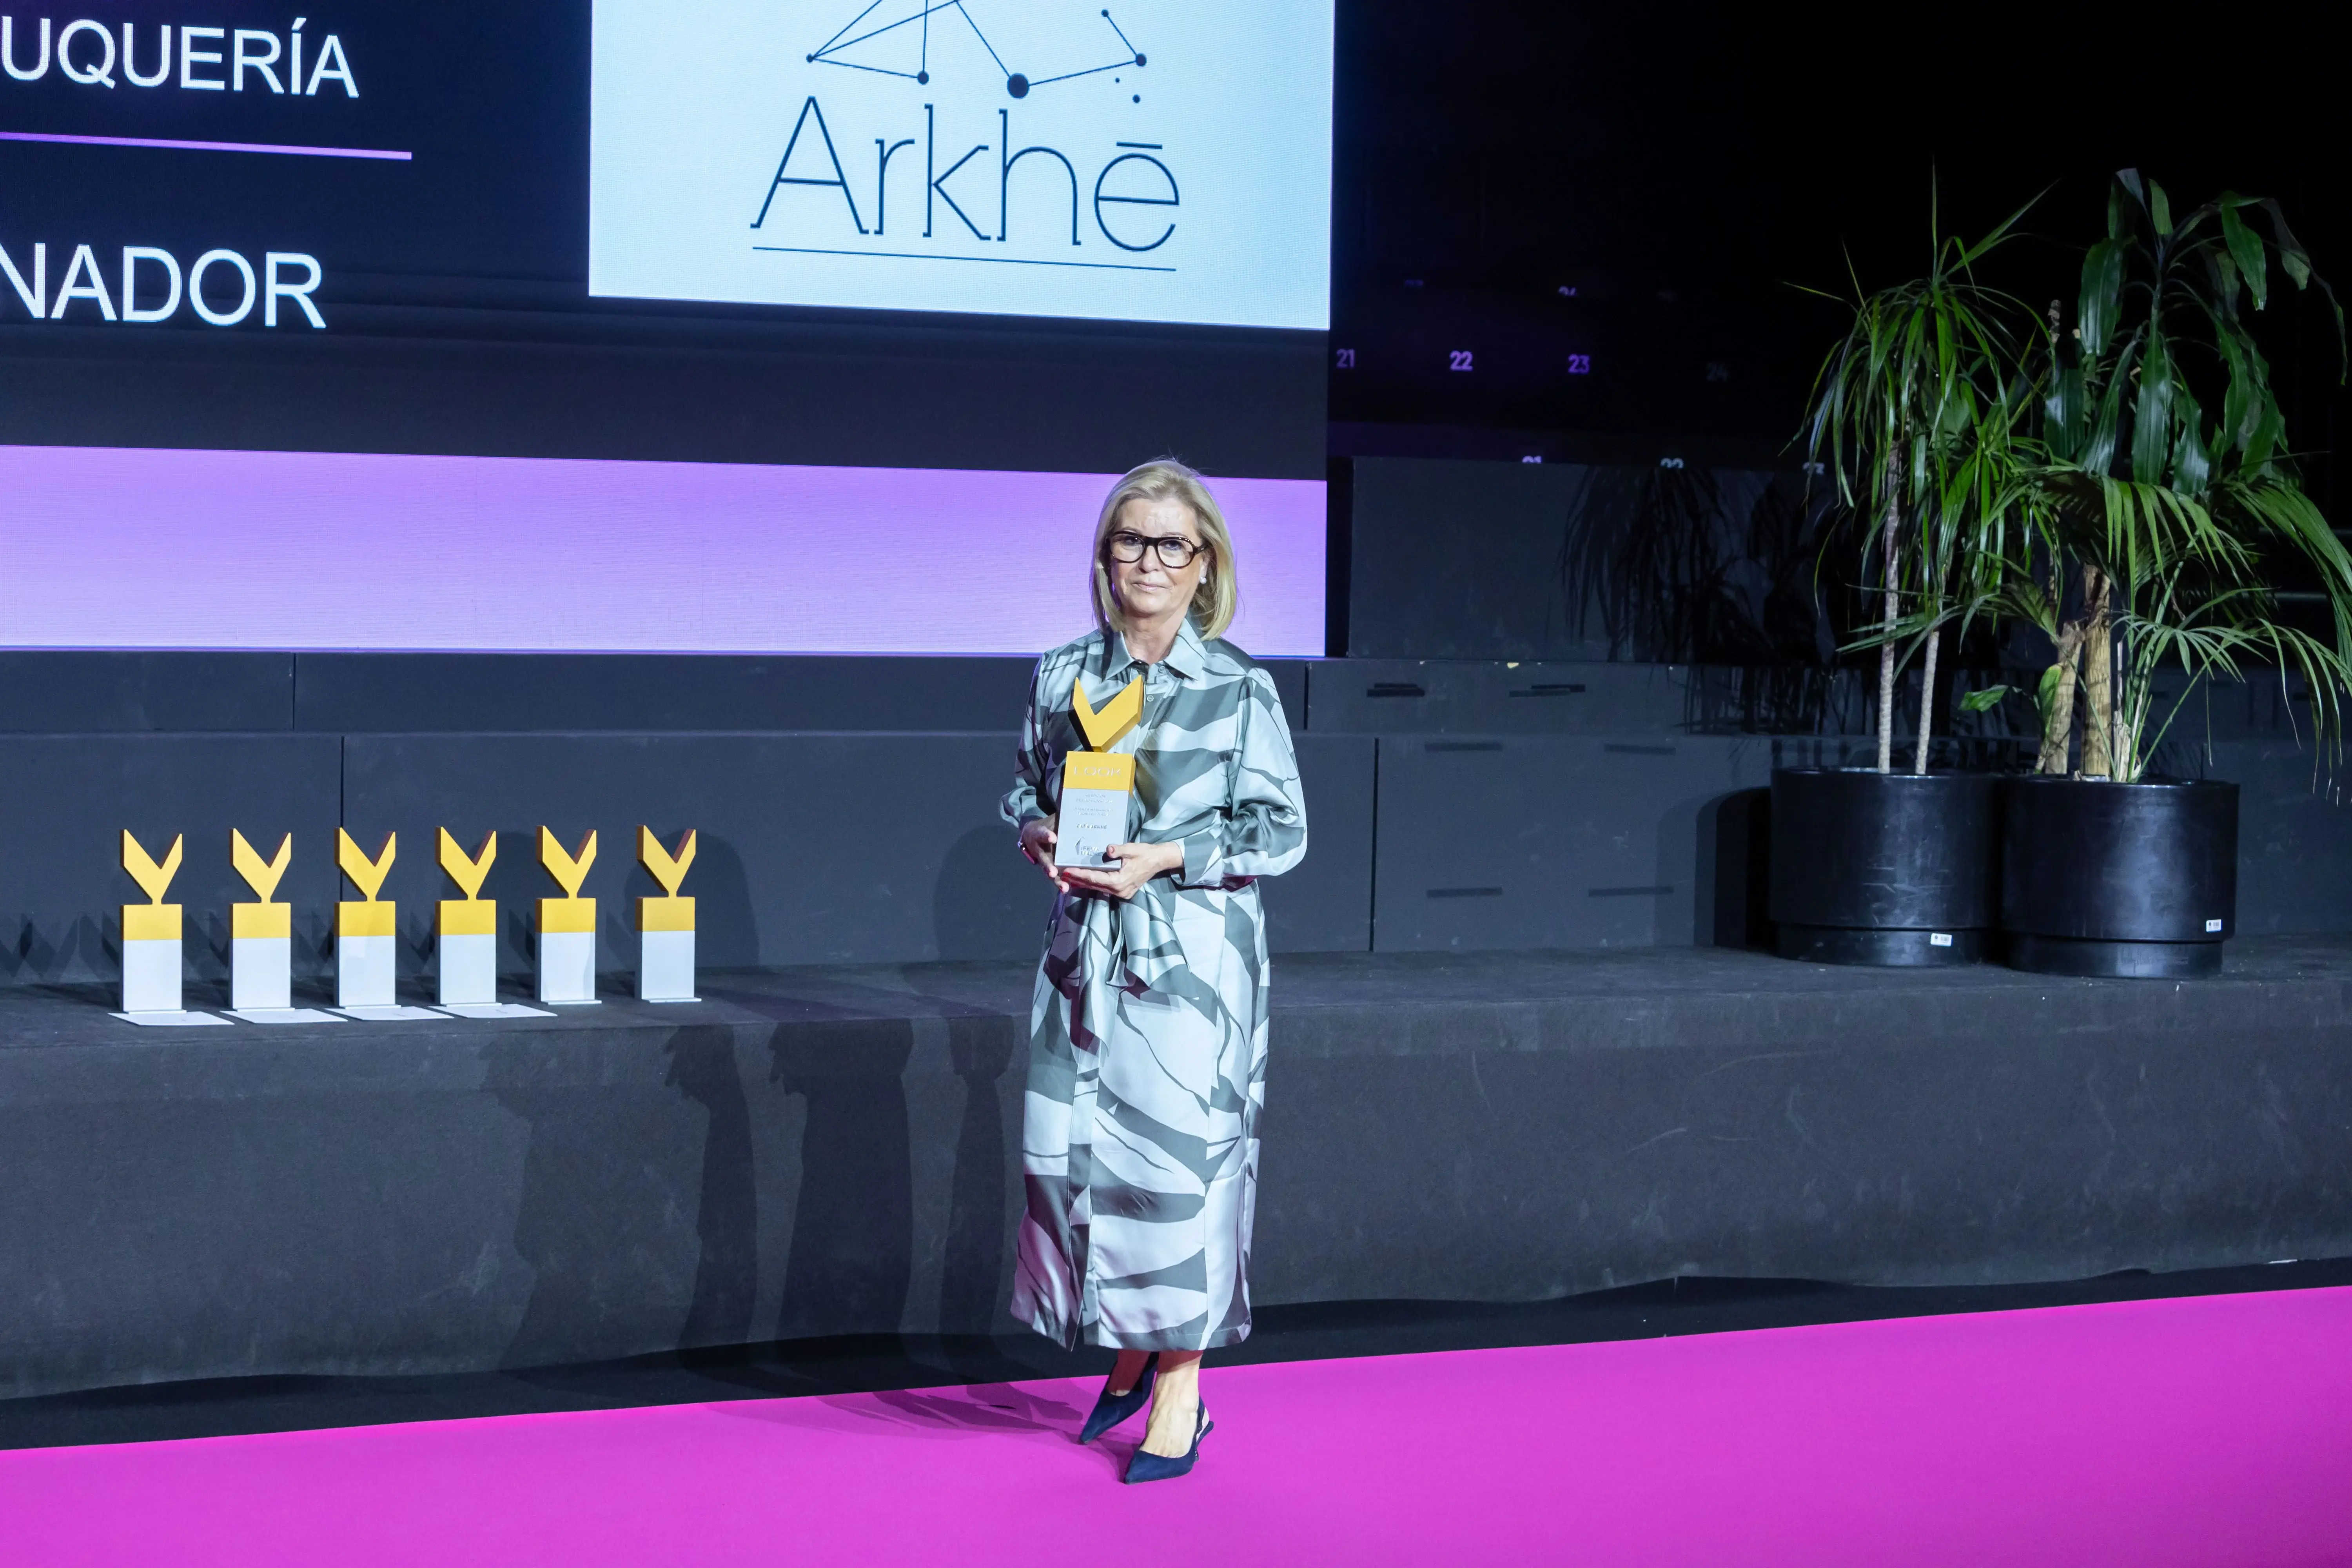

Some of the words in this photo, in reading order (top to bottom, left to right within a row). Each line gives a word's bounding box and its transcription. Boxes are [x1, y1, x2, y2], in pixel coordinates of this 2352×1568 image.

[2, 16, 359, 98] UQUERÍA
[1336, 348, 1356, 369] 21
[1449, 350, 1474, 371] 22
[1568, 354, 1590, 374] 23
[1074, 766, 1121, 777] LOOK
